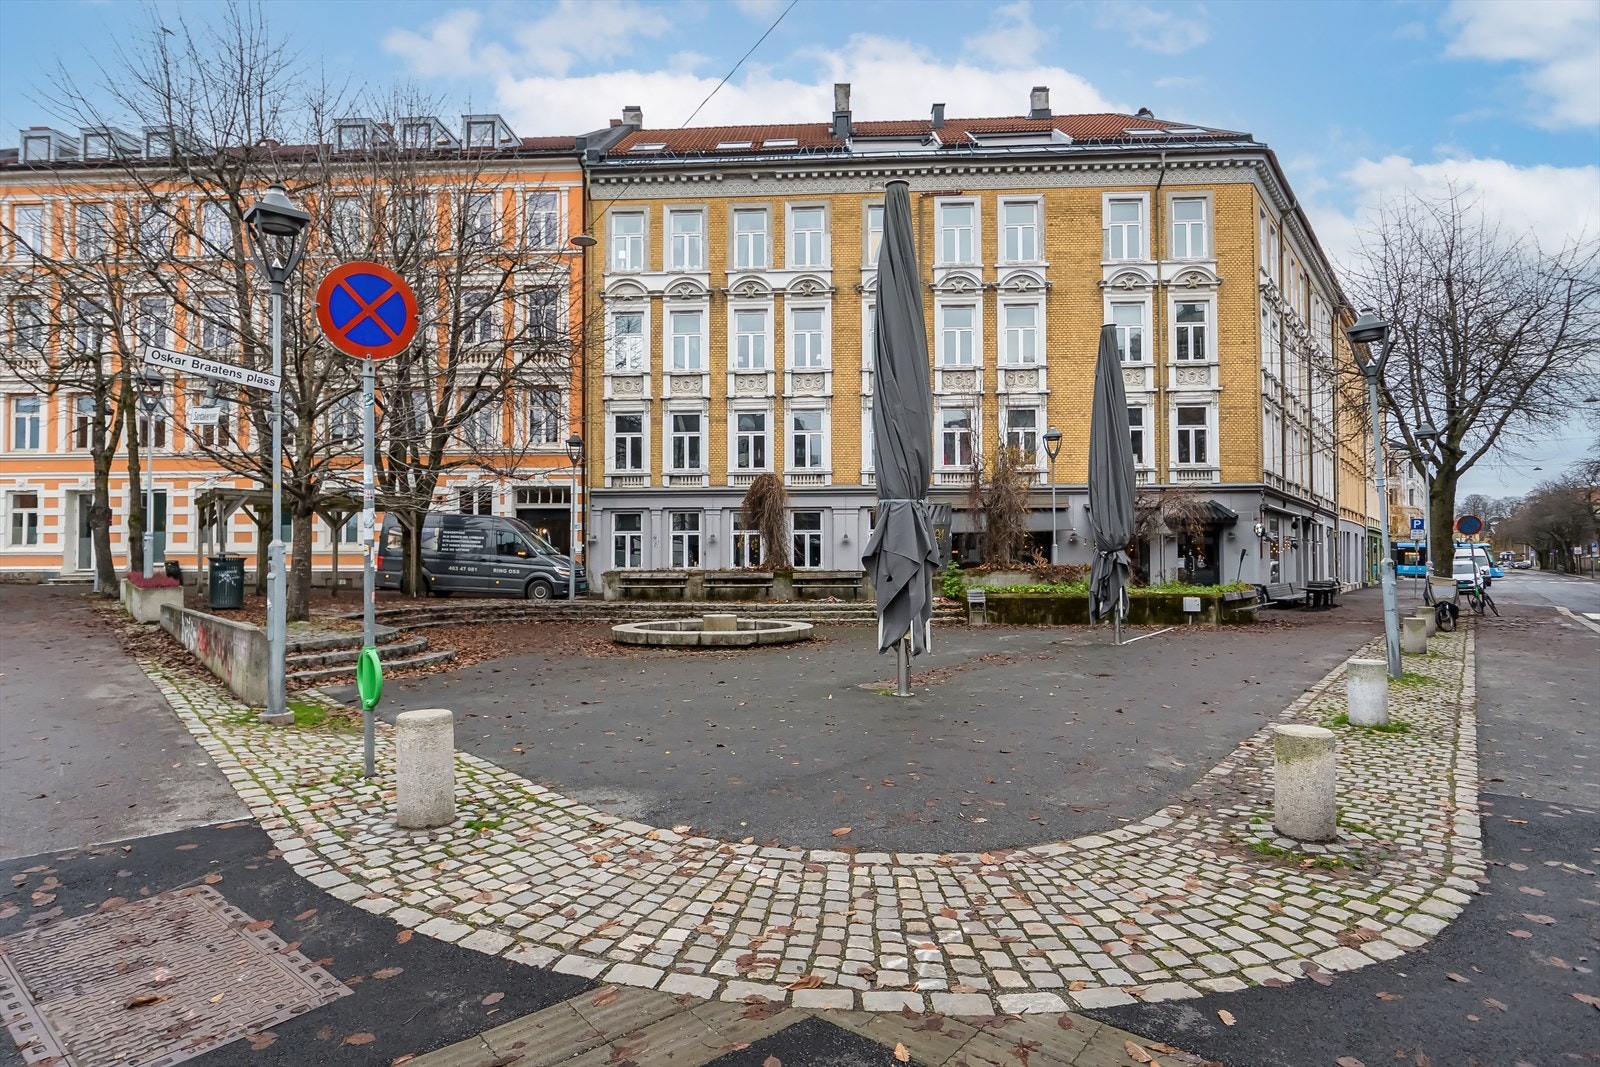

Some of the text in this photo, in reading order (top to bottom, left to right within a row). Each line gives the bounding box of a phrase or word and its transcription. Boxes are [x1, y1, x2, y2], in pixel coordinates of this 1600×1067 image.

[151, 349, 276, 387] Oskar Braatens plass
[1414, 520, 1421, 528] P
